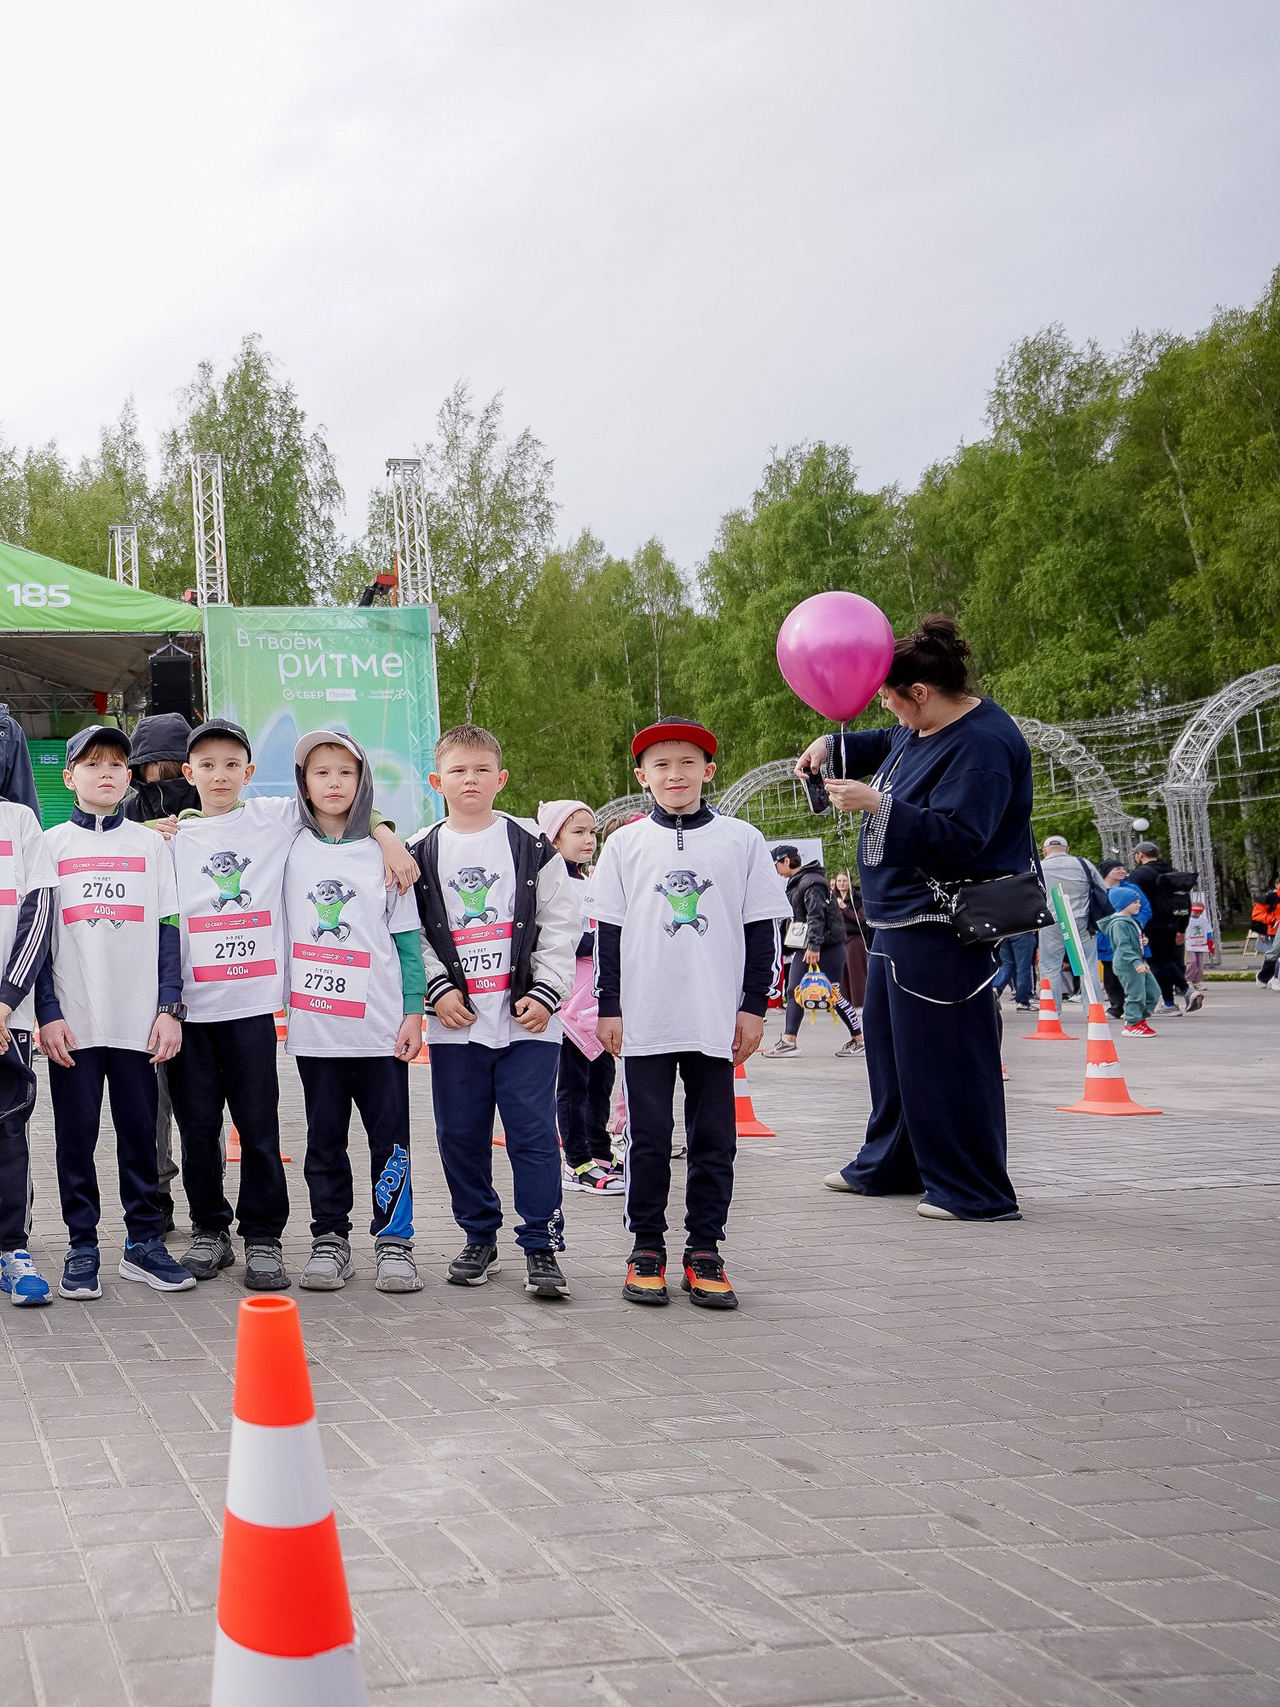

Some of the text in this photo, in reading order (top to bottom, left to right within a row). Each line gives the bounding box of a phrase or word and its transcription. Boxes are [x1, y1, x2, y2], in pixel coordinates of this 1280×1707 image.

[6, 583, 72, 608] 185
[236, 628, 323, 650] В твоём
[278, 652, 404, 686] ритме
[296, 691, 324, 700] СБЕР
[38, 754, 59, 764] 185
[82, 882, 126, 898] 2760
[93, 906, 116, 916] 400м
[214, 940, 256, 959] 2739
[226, 966, 248, 976] 400м
[461, 952, 502, 973] 2757
[304, 973, 346, 993] 2738
[475, 980, 496, 989] 400м
[309, 999, 332, 1010] 400м
[844, 1006, 860, 1030] KLEIN
